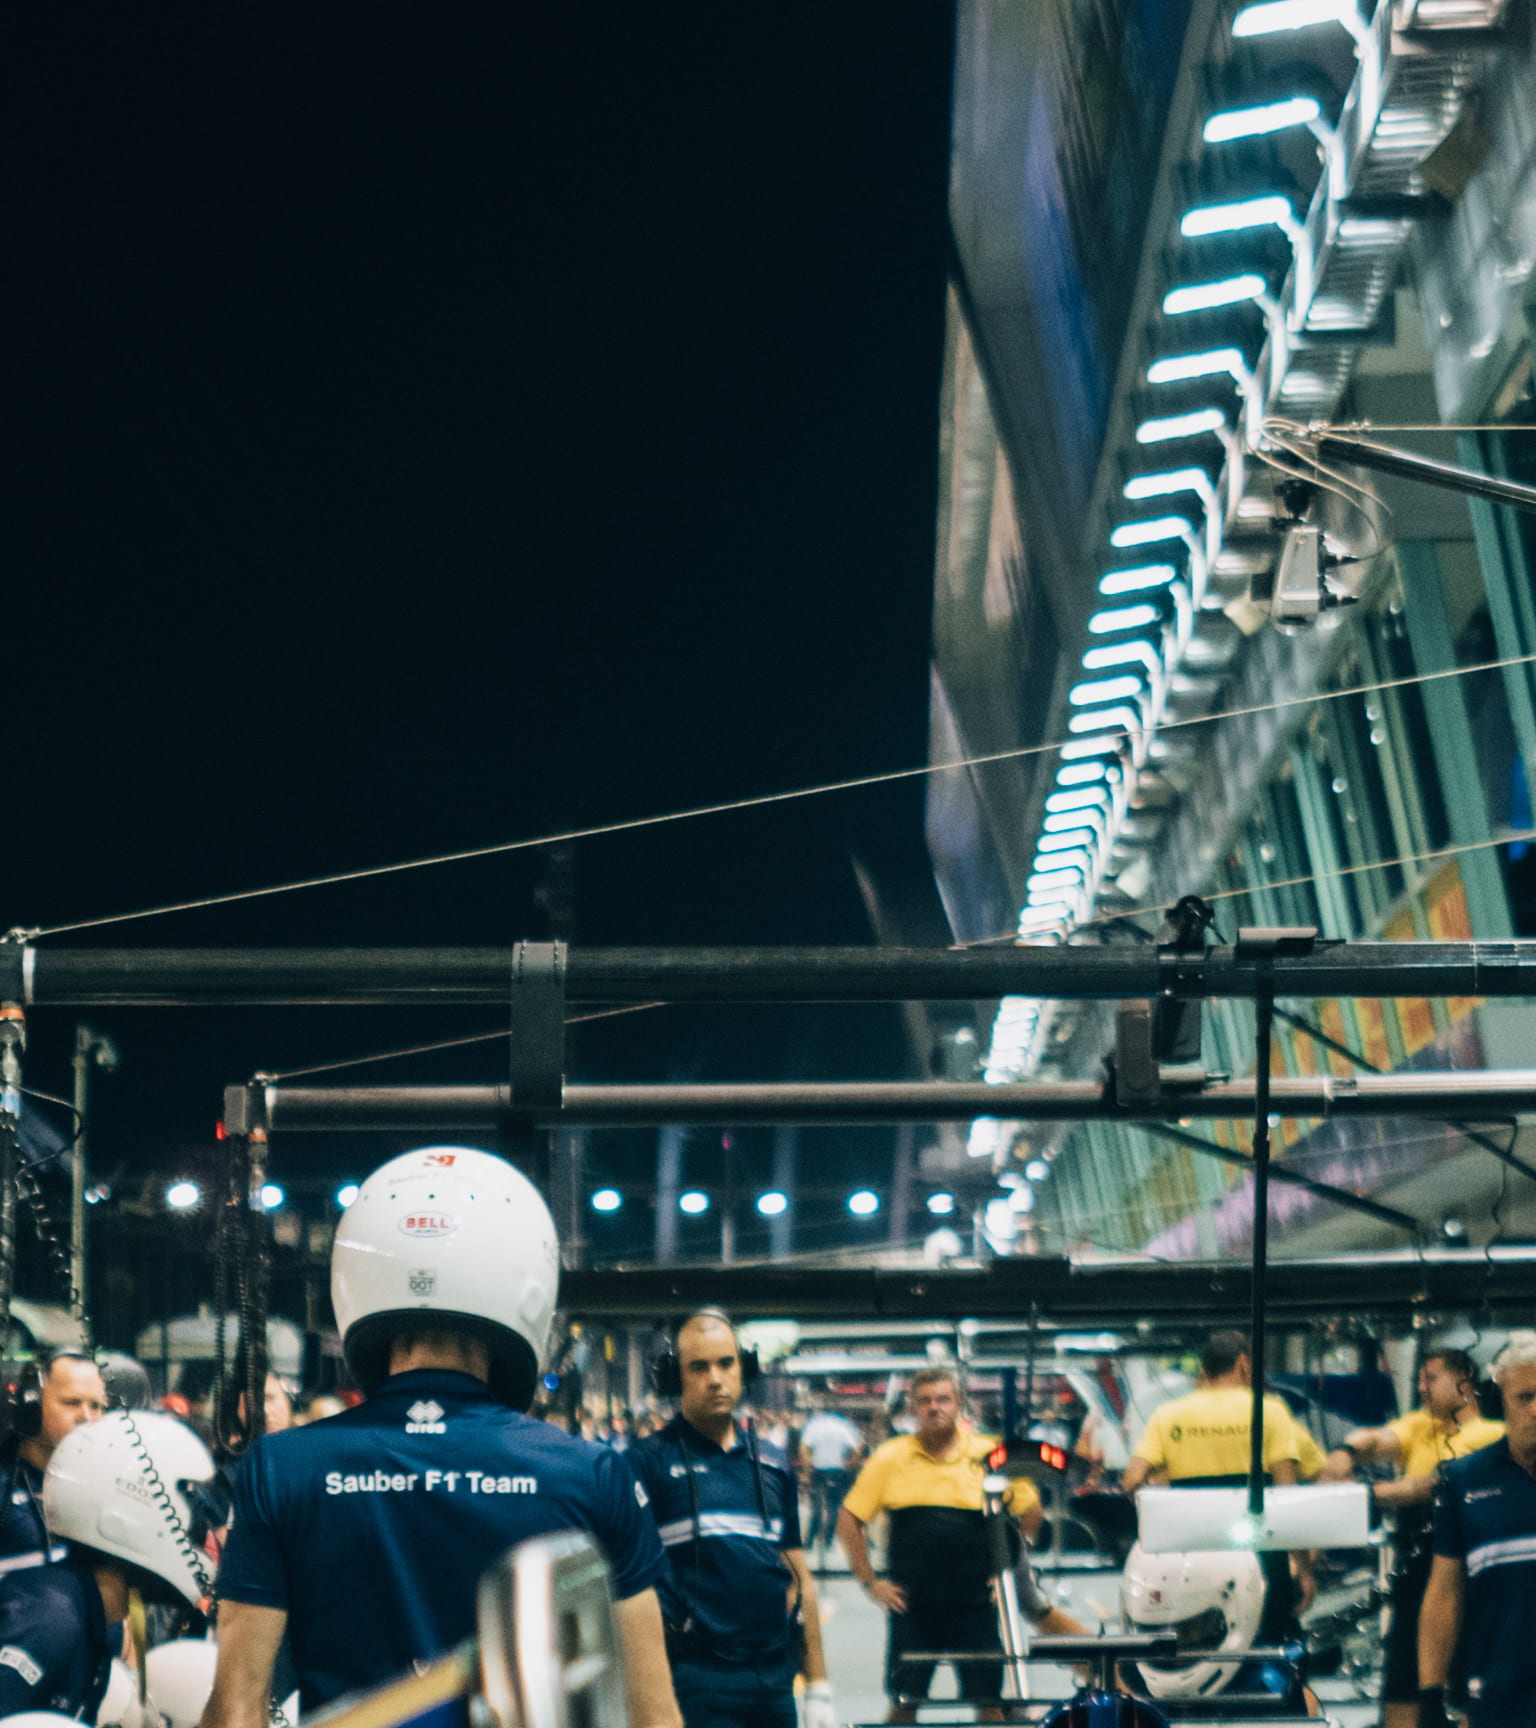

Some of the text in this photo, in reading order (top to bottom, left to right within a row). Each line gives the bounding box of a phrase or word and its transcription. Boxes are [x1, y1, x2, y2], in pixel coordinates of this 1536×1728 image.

[406, 1217, 449, 1229] BELL
[325, 1469, 537, 1495] Sauber F1 Team
